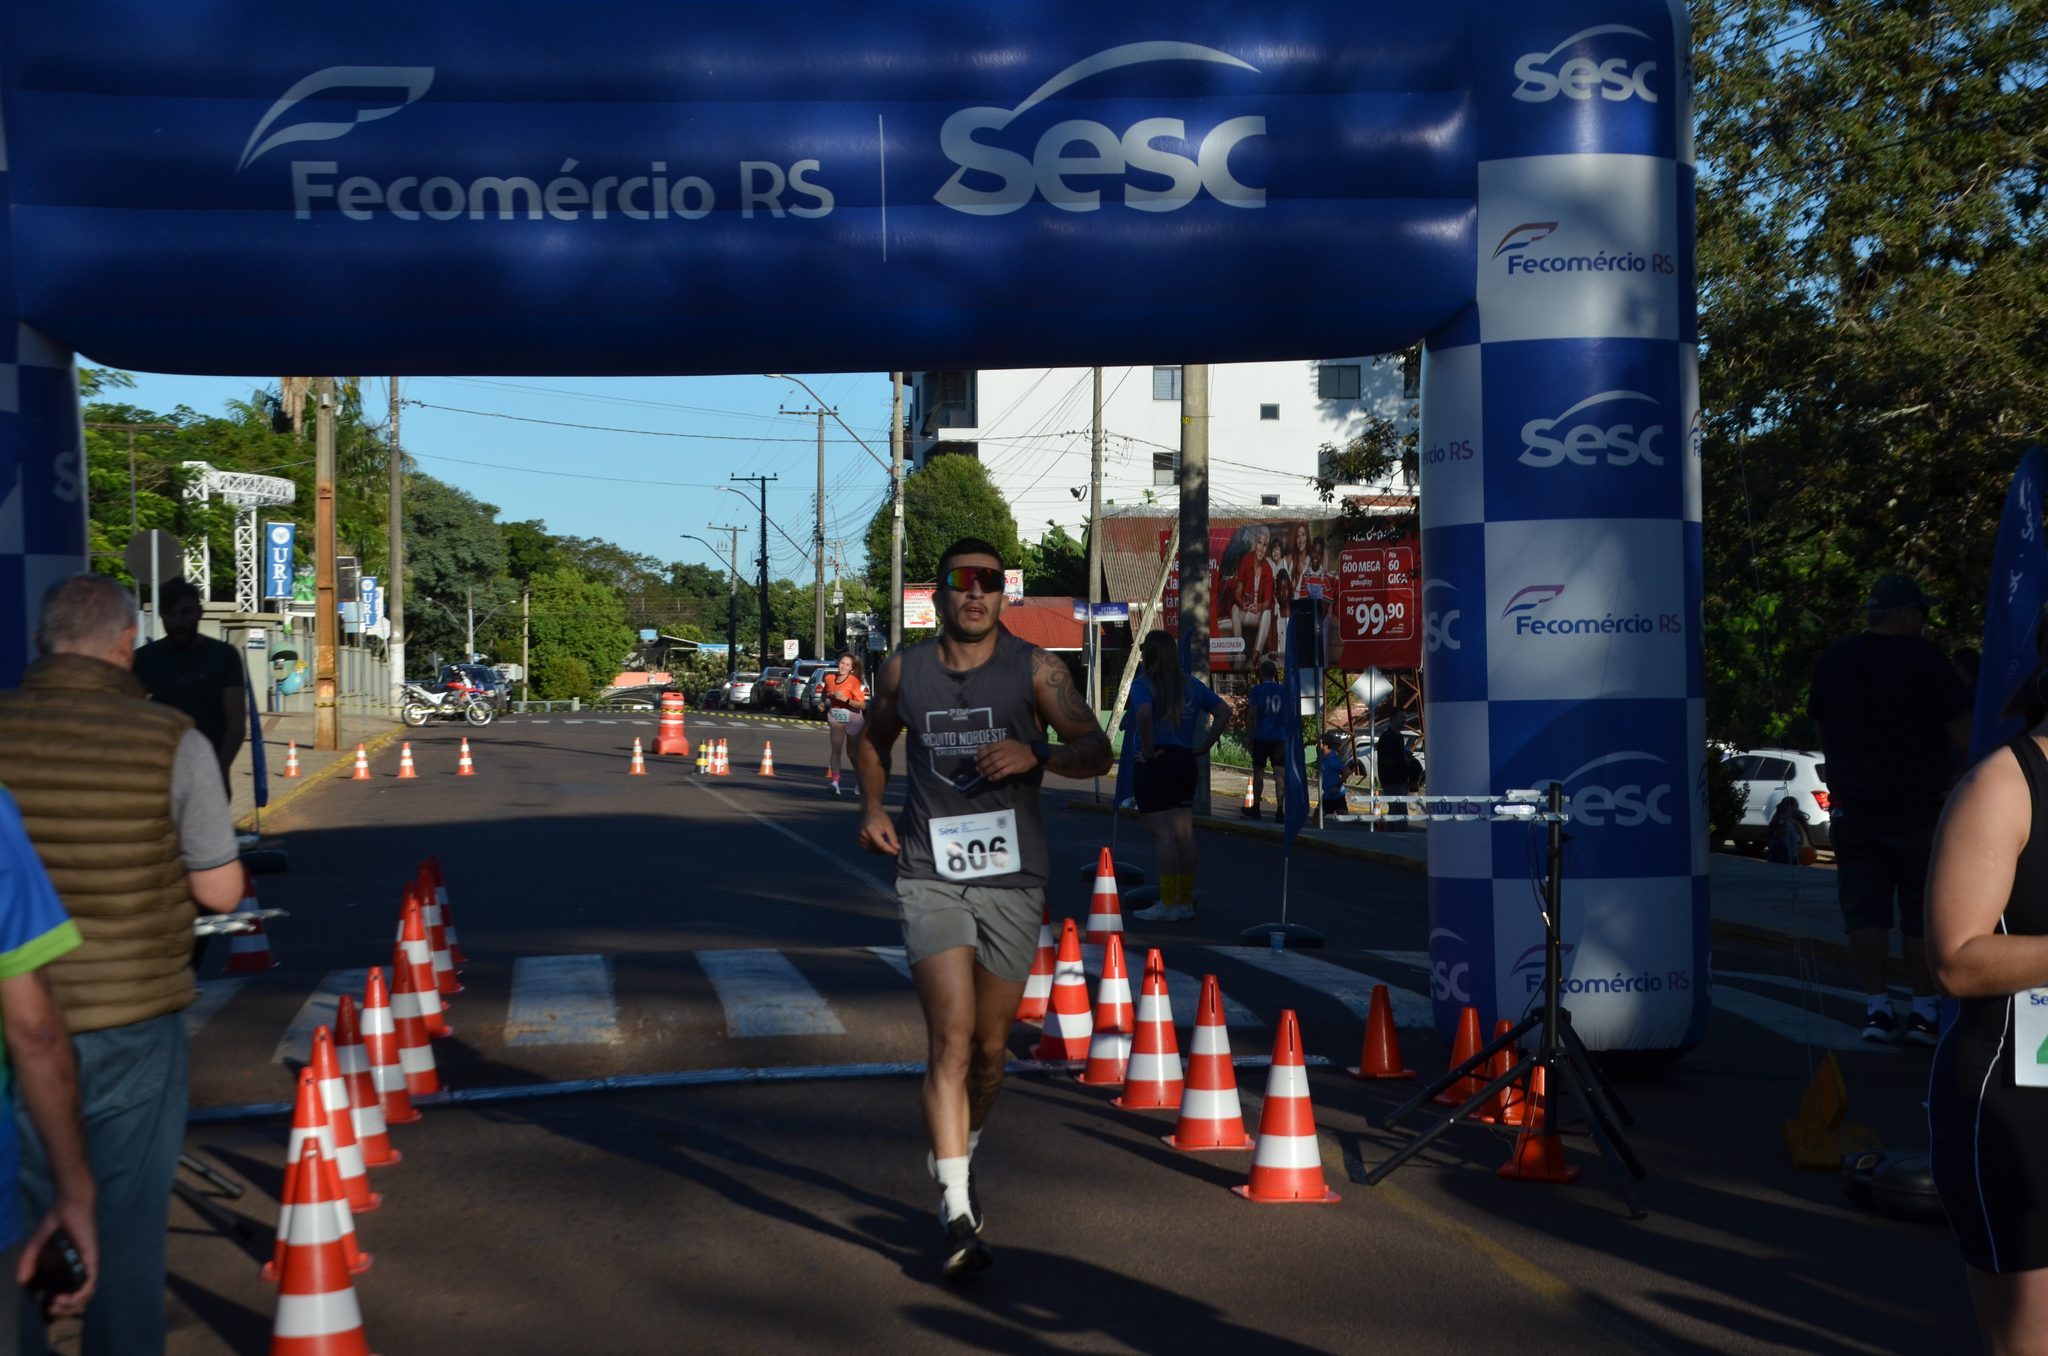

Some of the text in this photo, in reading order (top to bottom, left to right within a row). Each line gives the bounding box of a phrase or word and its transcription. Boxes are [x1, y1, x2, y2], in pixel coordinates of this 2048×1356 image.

[1510, 50, 1658, 103] Sesc
[933, 102, 1267, 216] Sesc
[289, 155, 835, 221] Fecomércio RS
[1507, 250, 1674, 275] Fecomércio RS
[1450, 440, 1474, 461] RS
[1517, 416, 1665, 468] Sesc
[272, 547, 289, 596] URI
[1342, 560, 1381, 573] 600 MEGA
[1388, 559, 1400, 571] 60
[1355, 602, 1405, 636] 99,90
[1515, 612, 1682, 636] Fecomércio RS
[1265, 693, 1281, 713] 10
[946, 836, 1010, 873] 806
[1668, 971, 1690, 991] RS
